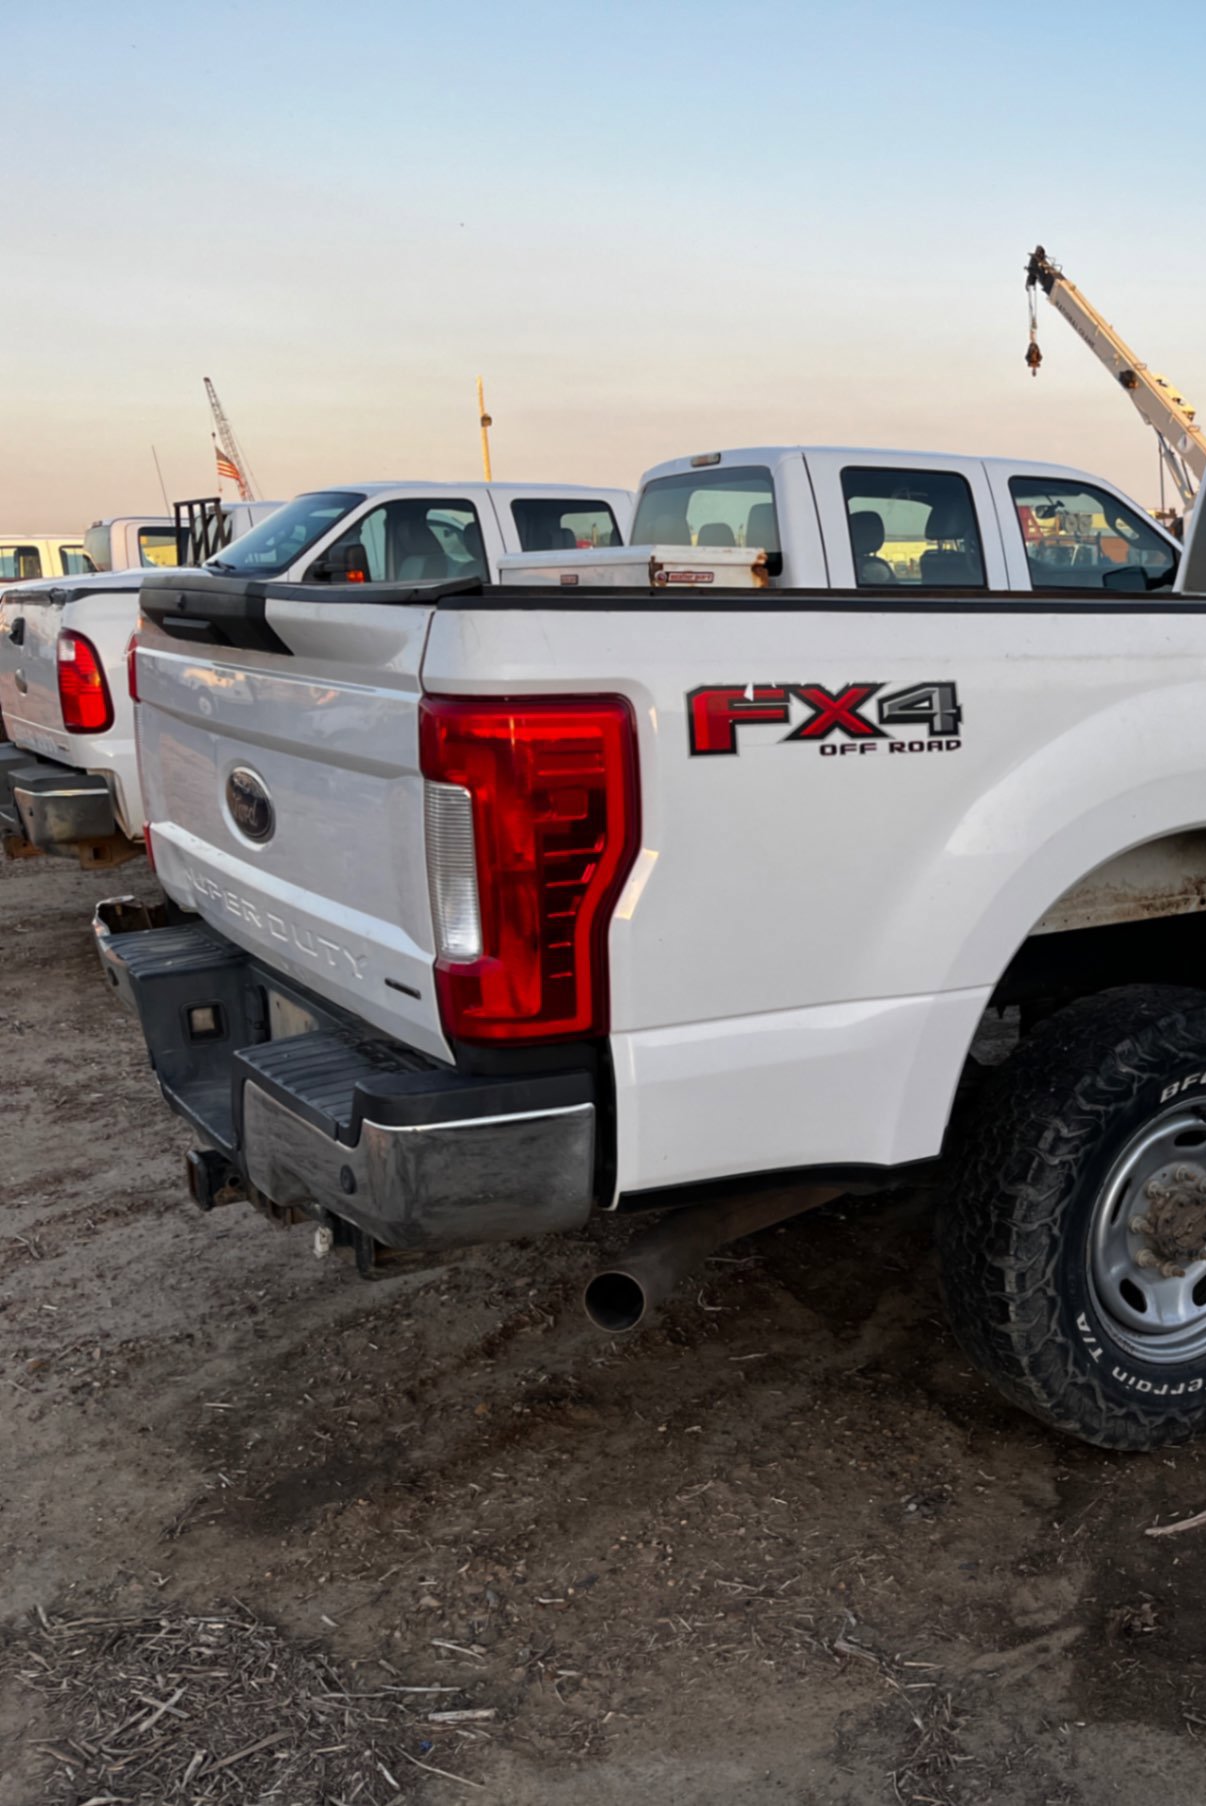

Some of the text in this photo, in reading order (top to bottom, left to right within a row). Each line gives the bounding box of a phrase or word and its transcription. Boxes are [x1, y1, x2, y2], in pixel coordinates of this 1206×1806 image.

[685, 680, 962, 757] FX4
[819, 739, 962, 757] OFF ROAD
[266, 911, 367, 980] DUTY
